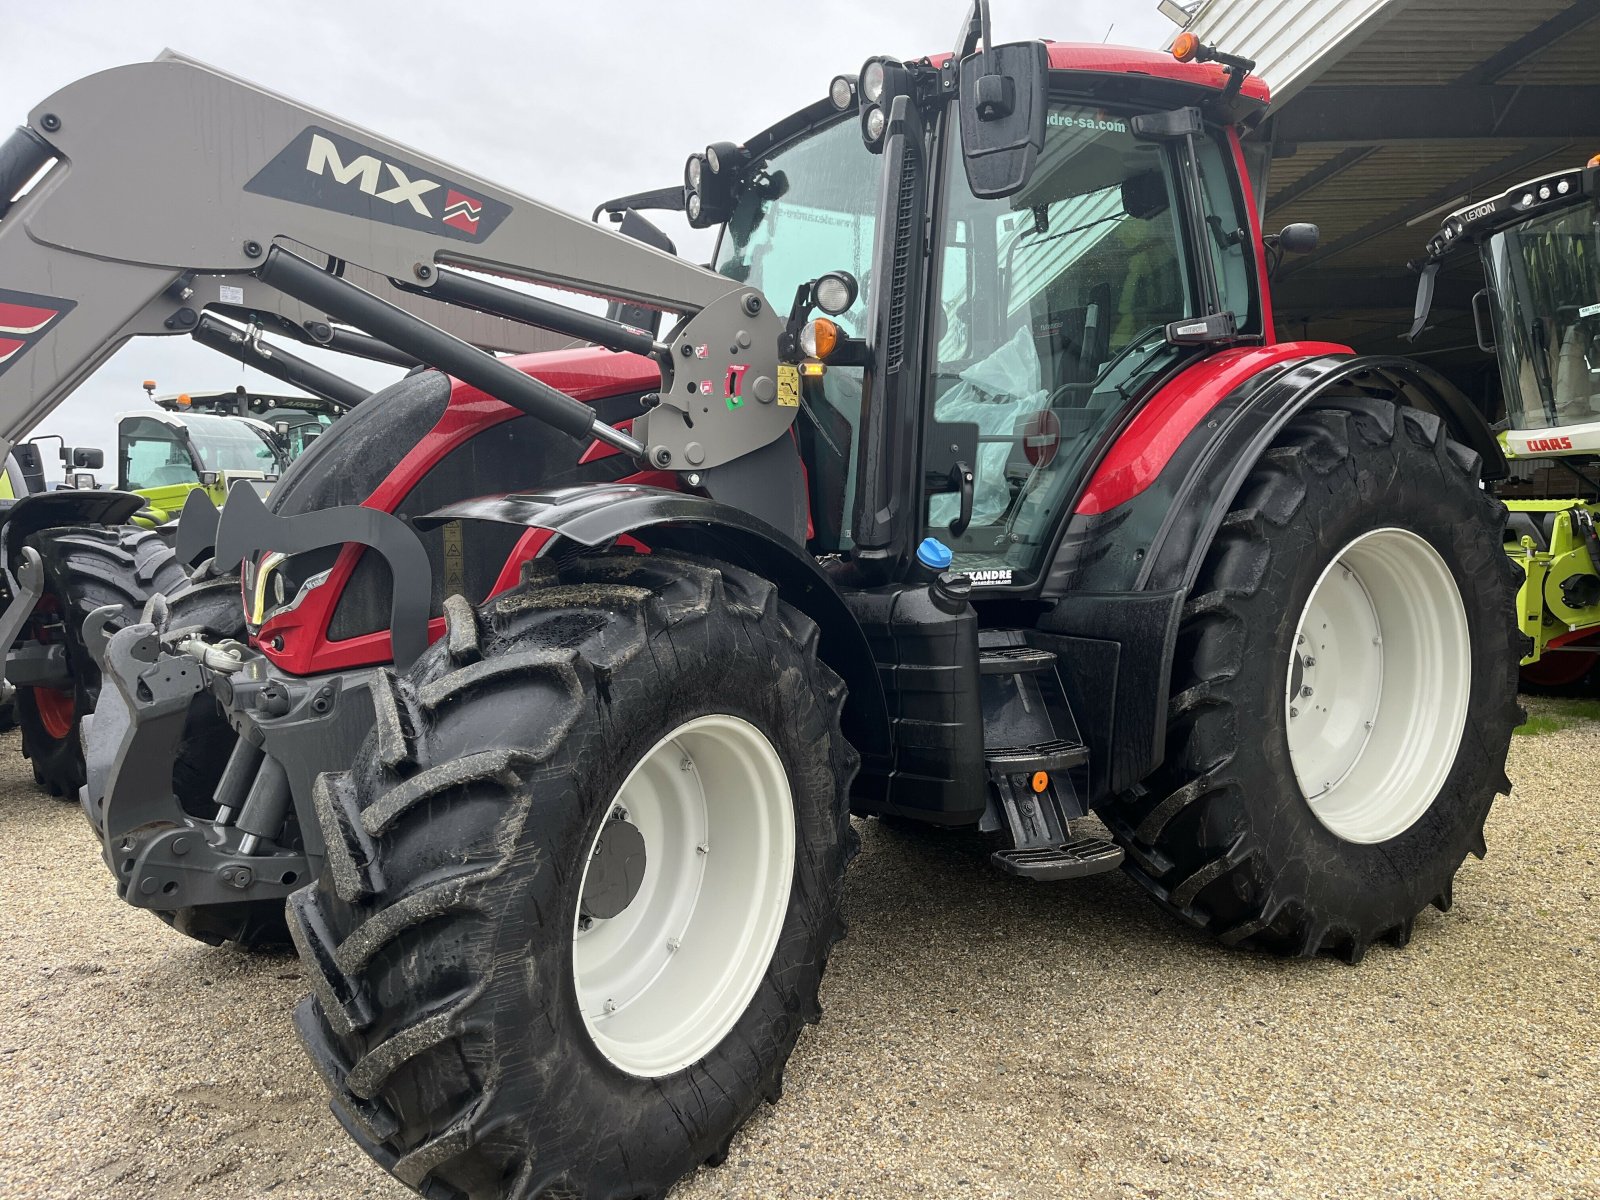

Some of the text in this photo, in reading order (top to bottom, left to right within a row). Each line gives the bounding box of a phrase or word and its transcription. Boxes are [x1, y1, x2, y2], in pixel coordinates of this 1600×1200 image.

[306, 133, 442, 220] MX
[1464, 202, 1496, 222] LEXION
[1526, 436, 1573, 452] CLAAS
[957, 569, 1012, 581] XANDRE
